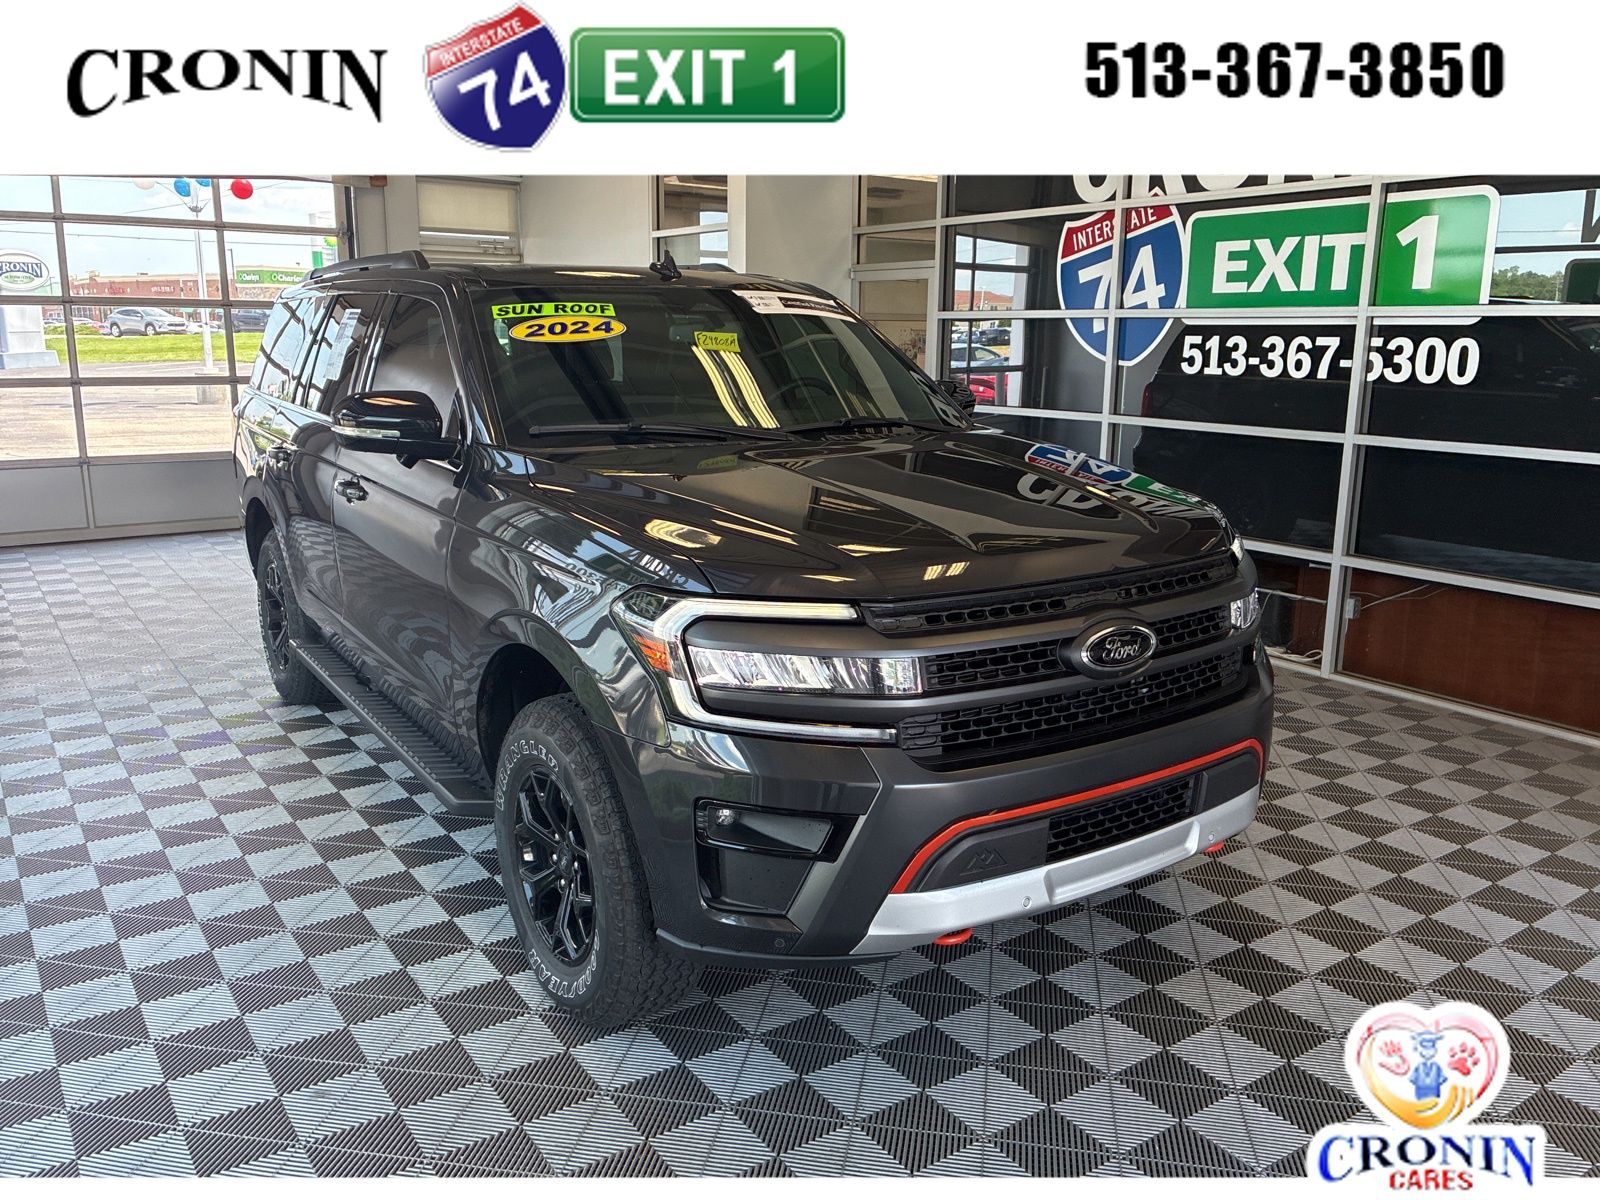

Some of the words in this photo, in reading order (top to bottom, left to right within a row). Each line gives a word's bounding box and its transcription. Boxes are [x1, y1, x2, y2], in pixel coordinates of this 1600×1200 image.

[1072, 206, 1157, 251] INTERATE
[0, 261, 43, 278] RONIN
[1211, 231, 1366, 293] EXIT
[1396, 214, 1440, 290] 1
[496, 304, 543, 317] SUN
[553, 303, 612, 315] ROOF
[1078, 244, 1165, 334] 74
[524, 320, 614, 338] 2024
[1180, 335, 1480, 385] 513-367-5300
[1103, 635, 1142, 660] Ford
[495, 739, 560, 812] WRANGLER
[528, 928, 600, 998] GOODYEAR
